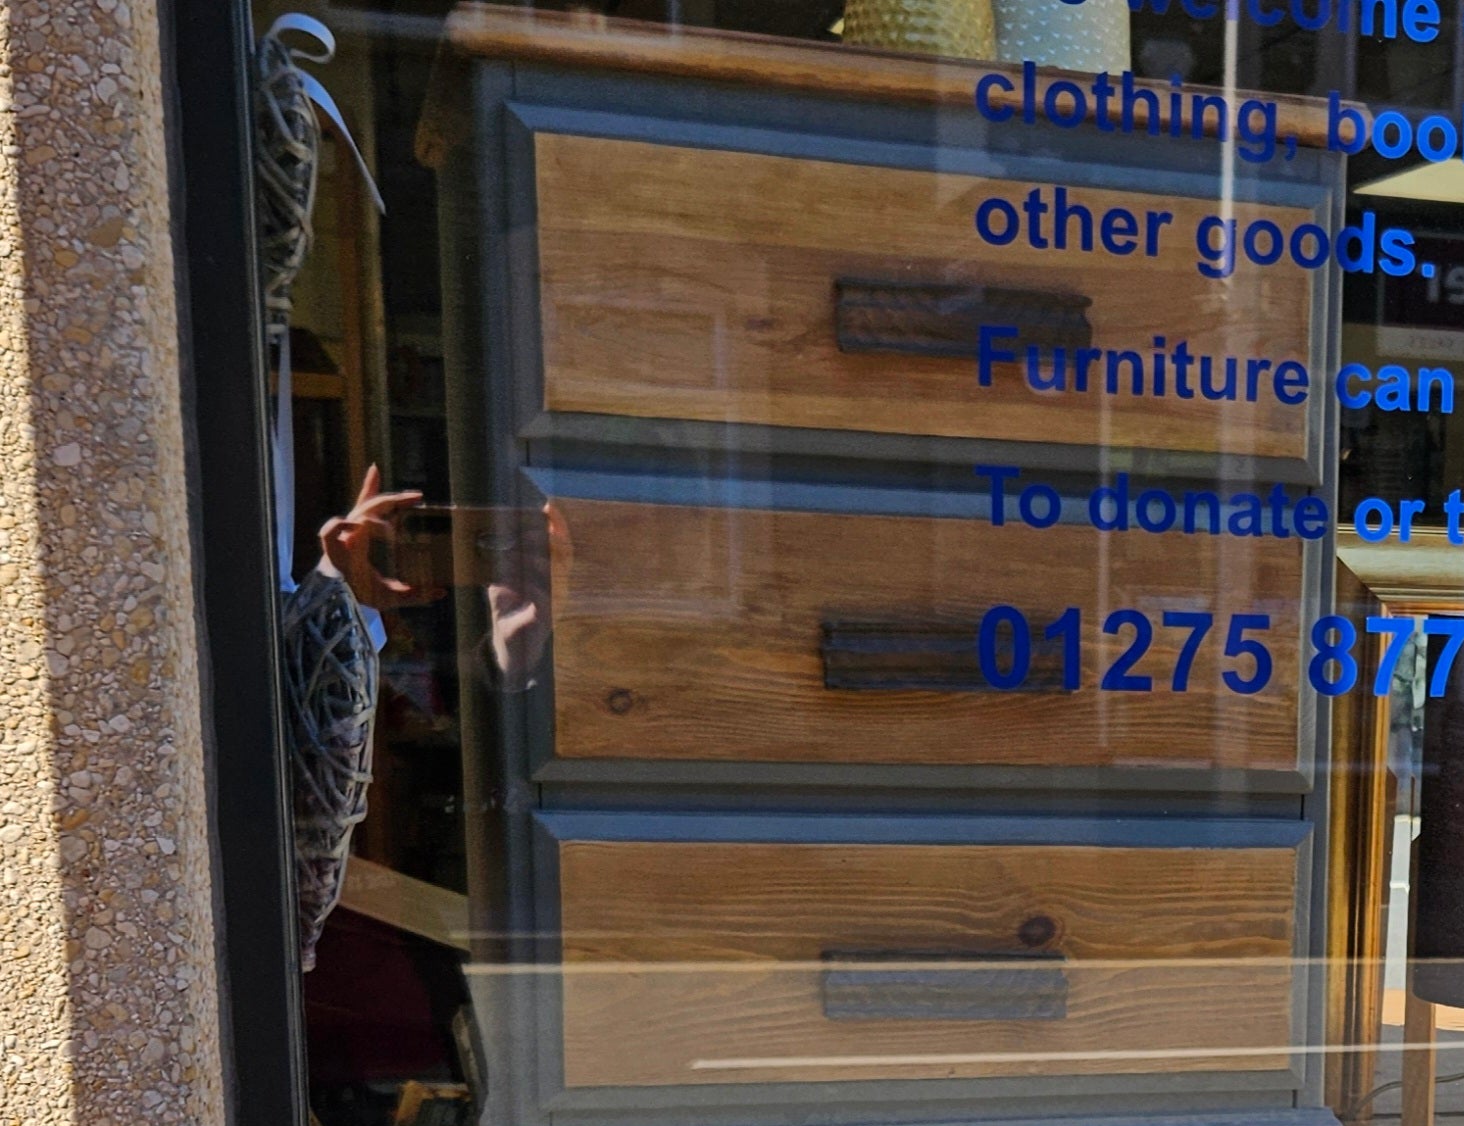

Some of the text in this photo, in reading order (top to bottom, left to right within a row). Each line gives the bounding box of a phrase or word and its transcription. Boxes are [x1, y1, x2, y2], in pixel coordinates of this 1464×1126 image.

[975, 60, 1297, 165] clothing,
[975, 188, 1439, 279] other goods.
[977, 325, 1311, 405] Furniture
[1335, 362, 1456, 416] can
[975, 465, 1065, 528] To
[1087, 472, 1330, 541] donate
[1353, 497, 1427, 544] or
[976, 605, 1273, 695] 01275
